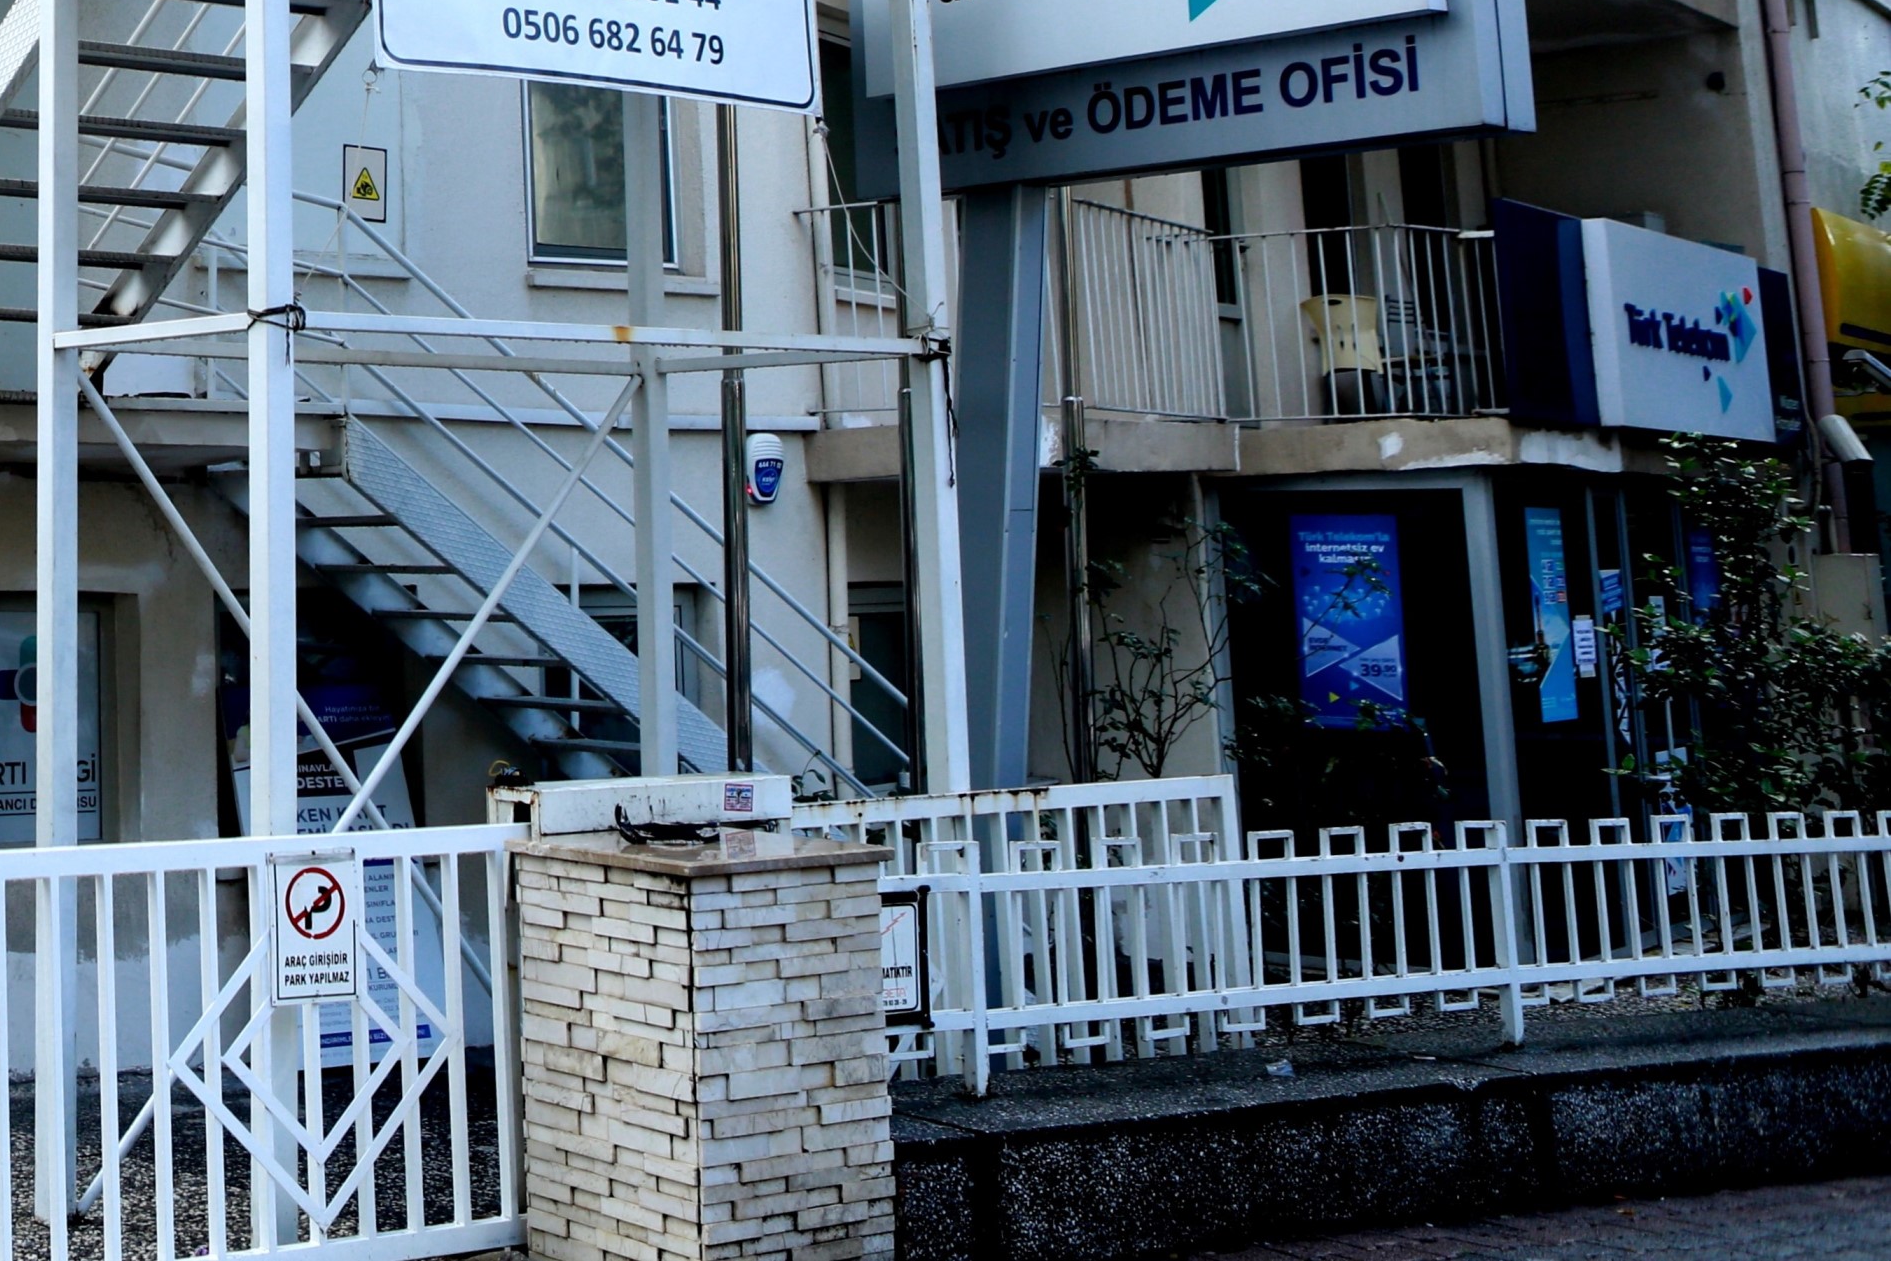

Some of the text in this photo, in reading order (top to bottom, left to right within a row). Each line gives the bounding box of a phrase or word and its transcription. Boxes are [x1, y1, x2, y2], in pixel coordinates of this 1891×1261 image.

[502, 6, 726, 65] 0506 682 64 79
[936, 33, 1420, 160] TIŞ ve ÖDEME OFİSİ
[297, 776, 349, 789] DESTE
[297, 807, 331, 823] KEN
[366, 900, 396, 908] SINIFLA
[376, 915, 396, 924] DEST
[285, 950, 348, 970] ARAÇ GİRİŞİDİR
[285, 971, 350, 987] PARK YAPILMAZ
